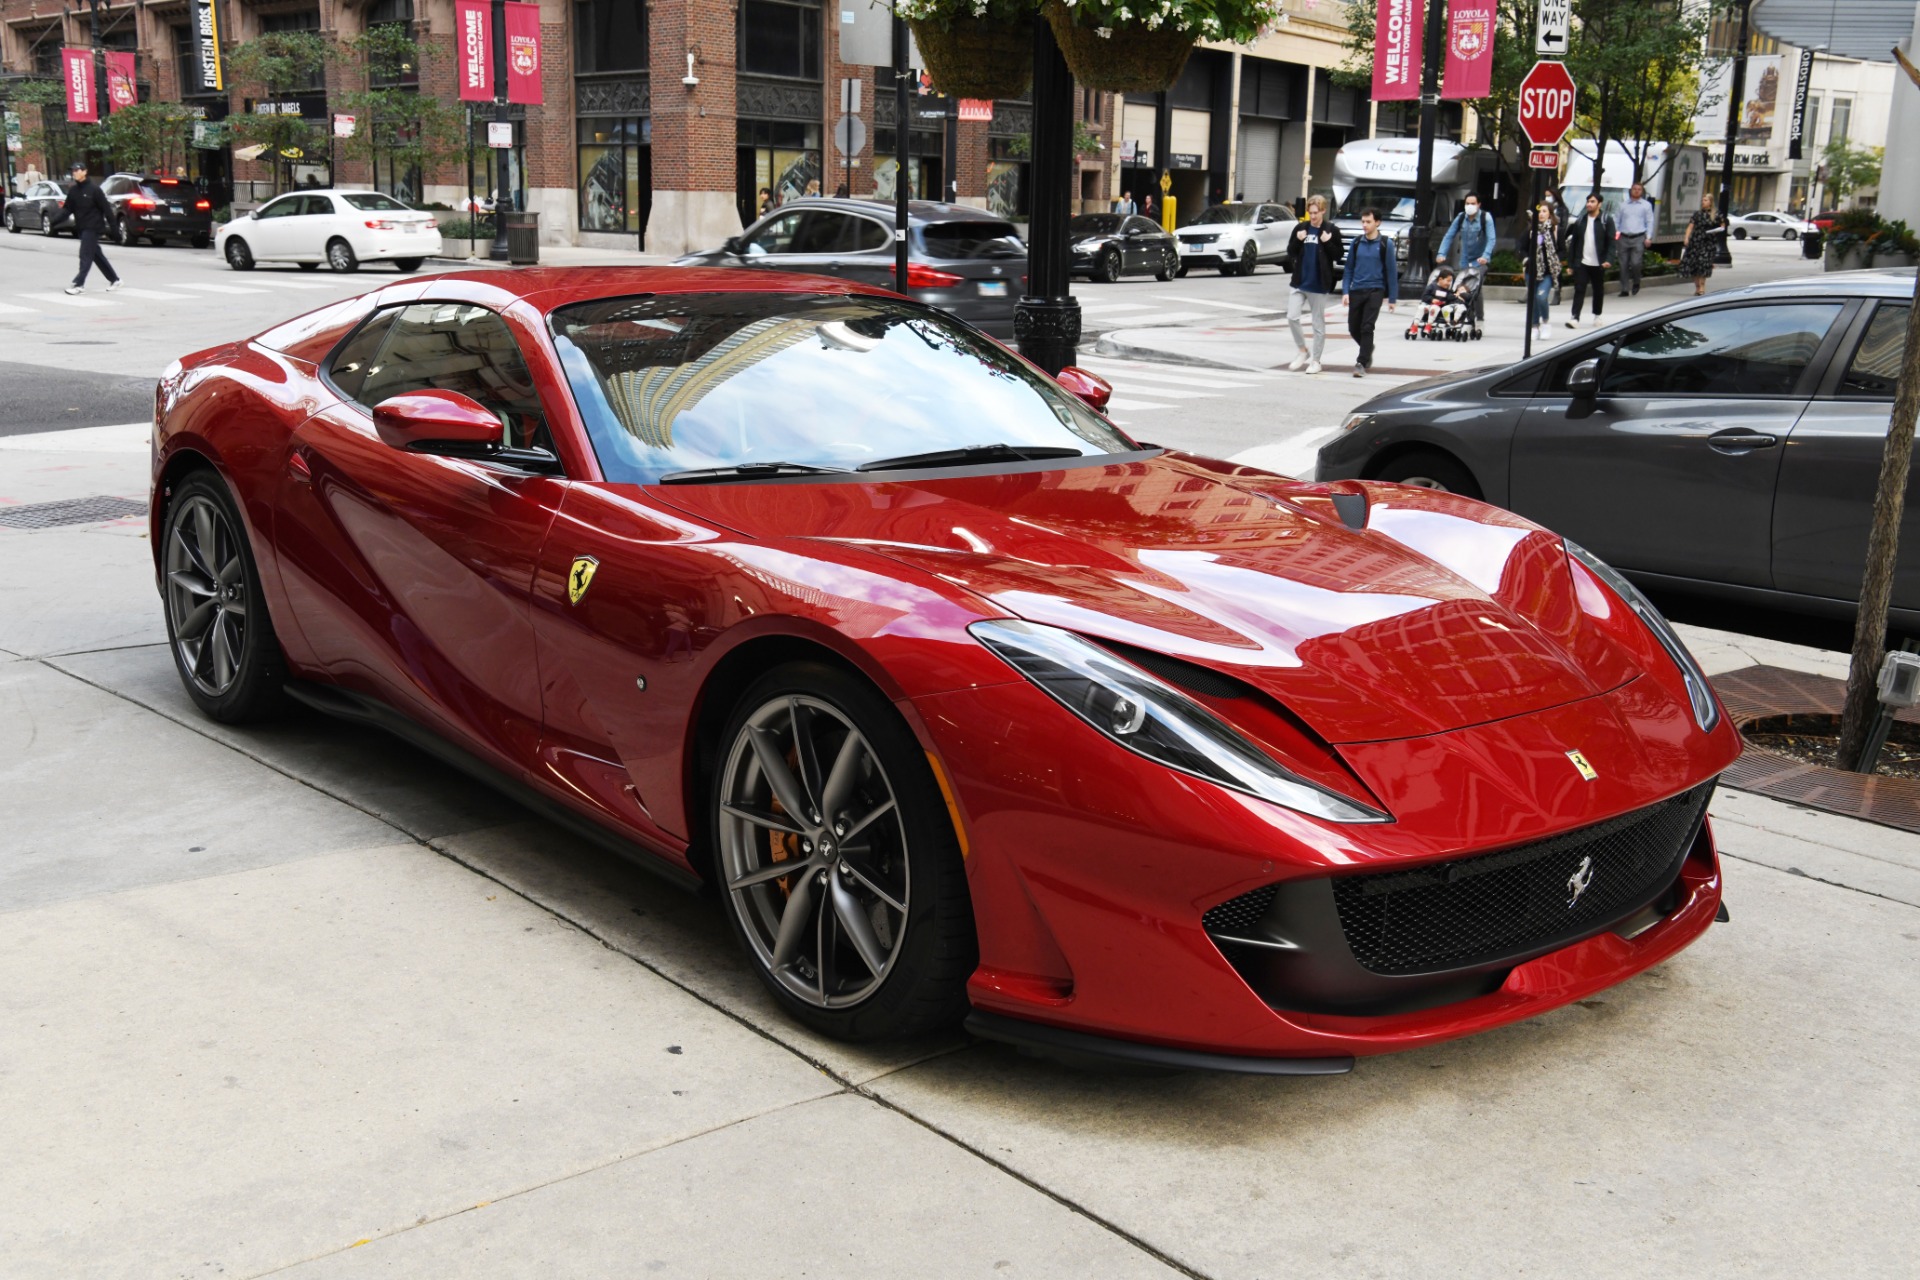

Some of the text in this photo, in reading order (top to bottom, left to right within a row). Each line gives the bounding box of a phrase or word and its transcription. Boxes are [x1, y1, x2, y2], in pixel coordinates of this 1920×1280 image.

[198, 7, 214, 36] BROS.
[1453, 9, 1489, 19] LOYOLA
[1541, 10, 1567, 26] WAY
[465, 10, 479, 88] WELCOME
[510, 35, 536, 44] LOYOLA
[1385, 0, 1404, 85] WELCOM
[1400, 0, 1413, 85] WATER TOWER CAMP
[201, 38, 217, 88] EINSTEIN
[70, 57, 84, 113] WELCOME
[1791, 48, 1811, 140] ORDSTROM rack
[281, 102, 300, 114] BAGELS
[1522, 88, 1572, 120] STOP
[1365, 160, 1418, 172] The Clar
[1532, 154, 1556, 165] ALL WAY
[1751, 151, 1770, 165] rack
